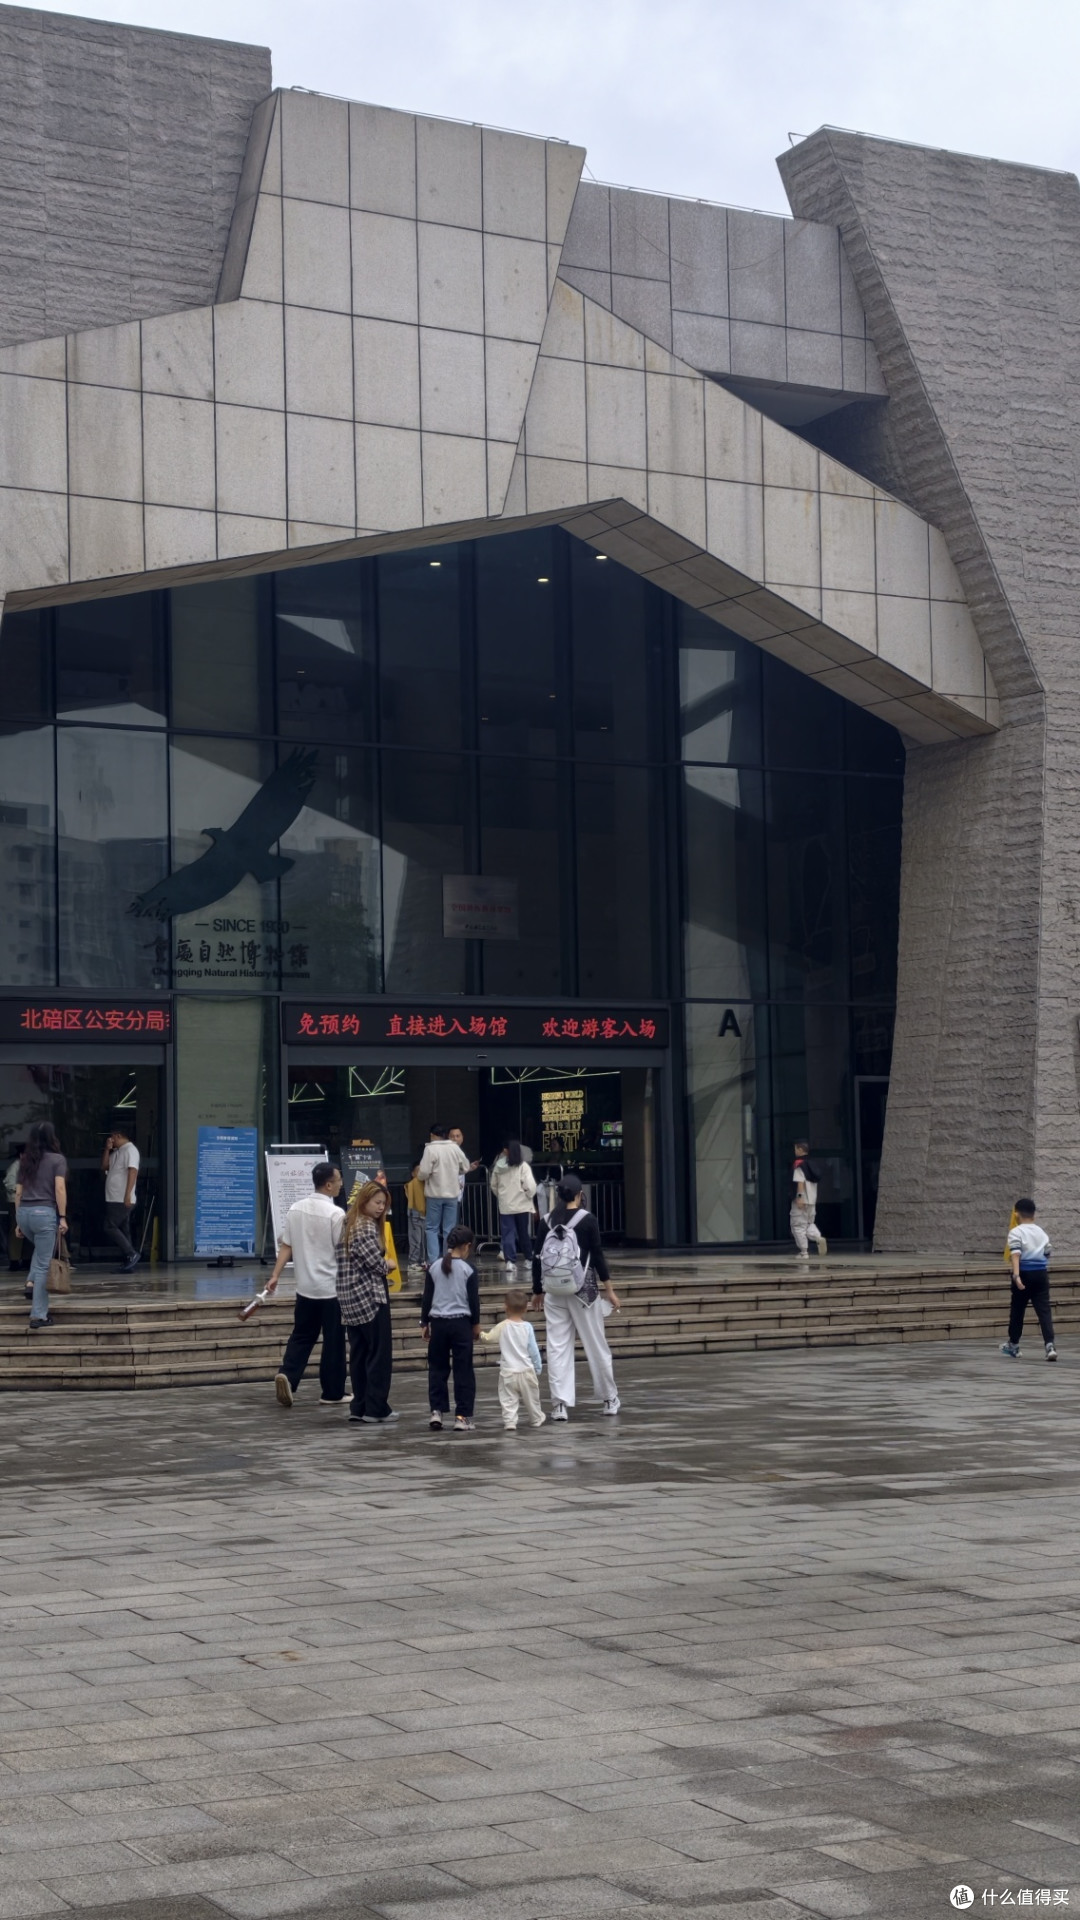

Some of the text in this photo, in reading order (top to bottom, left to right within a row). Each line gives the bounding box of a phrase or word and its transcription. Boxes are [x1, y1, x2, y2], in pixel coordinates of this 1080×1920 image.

[213, 918, 256, 933] SINCE
[204, 968, 237, 977] Natural
[239, 969, 271, 980] History
[20, 1008, 170, 1031] 北碚区公安分局
[297, 1012, 656, 1039] 免预约 直接进入场馆 欢迎游客入场
[717, 1008, 743, 1037] A
